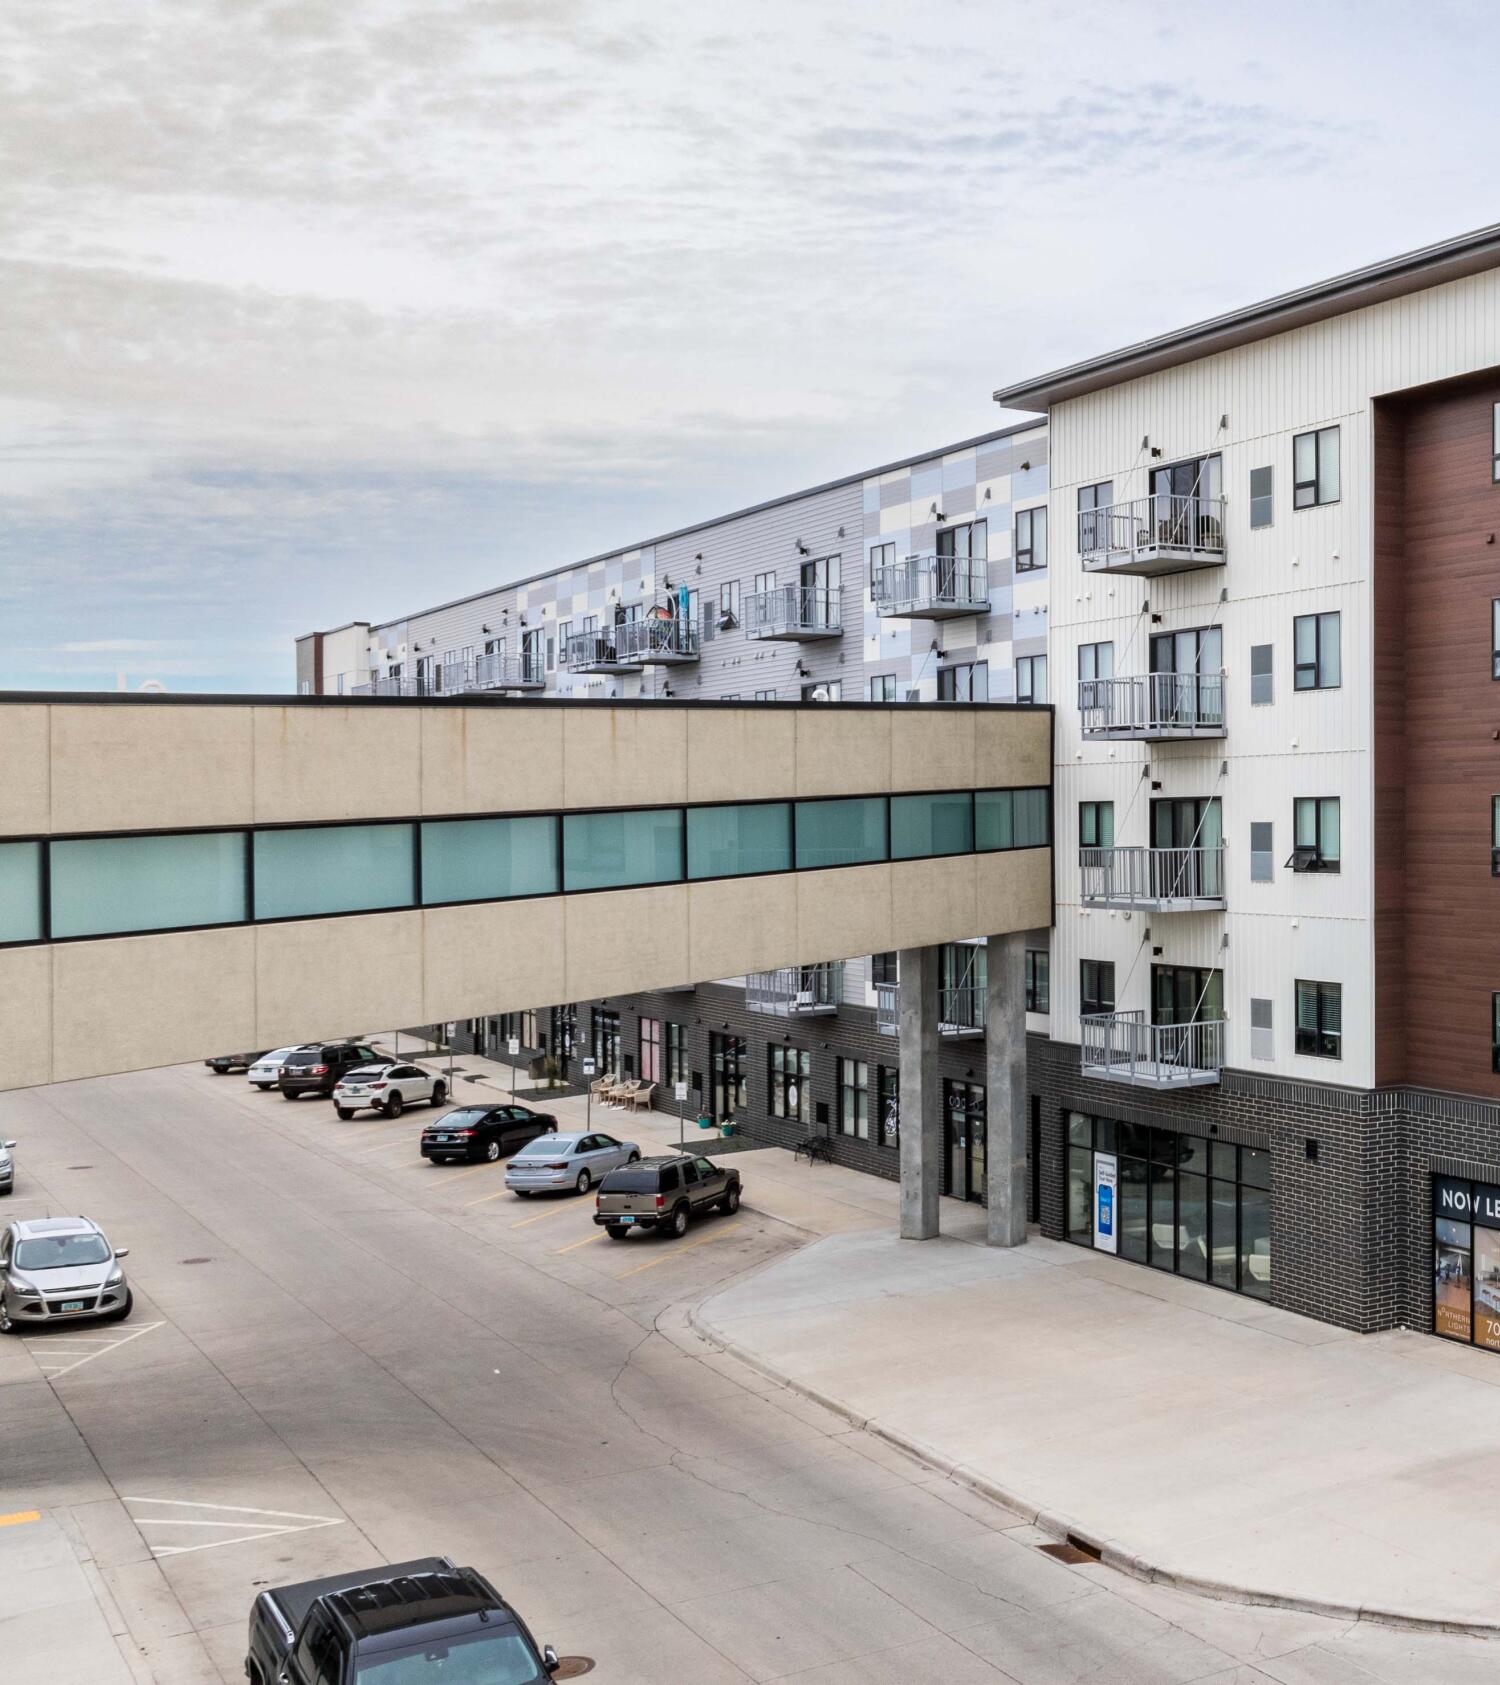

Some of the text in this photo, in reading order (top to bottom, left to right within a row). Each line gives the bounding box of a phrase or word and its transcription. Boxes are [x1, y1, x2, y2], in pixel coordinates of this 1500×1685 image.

[1442, 1188, 1479, 1214] NOW
[1437, 1306, 1470, 1323] NORTHERN
[1447, 1321, 1470, 1332] LIGHTS
